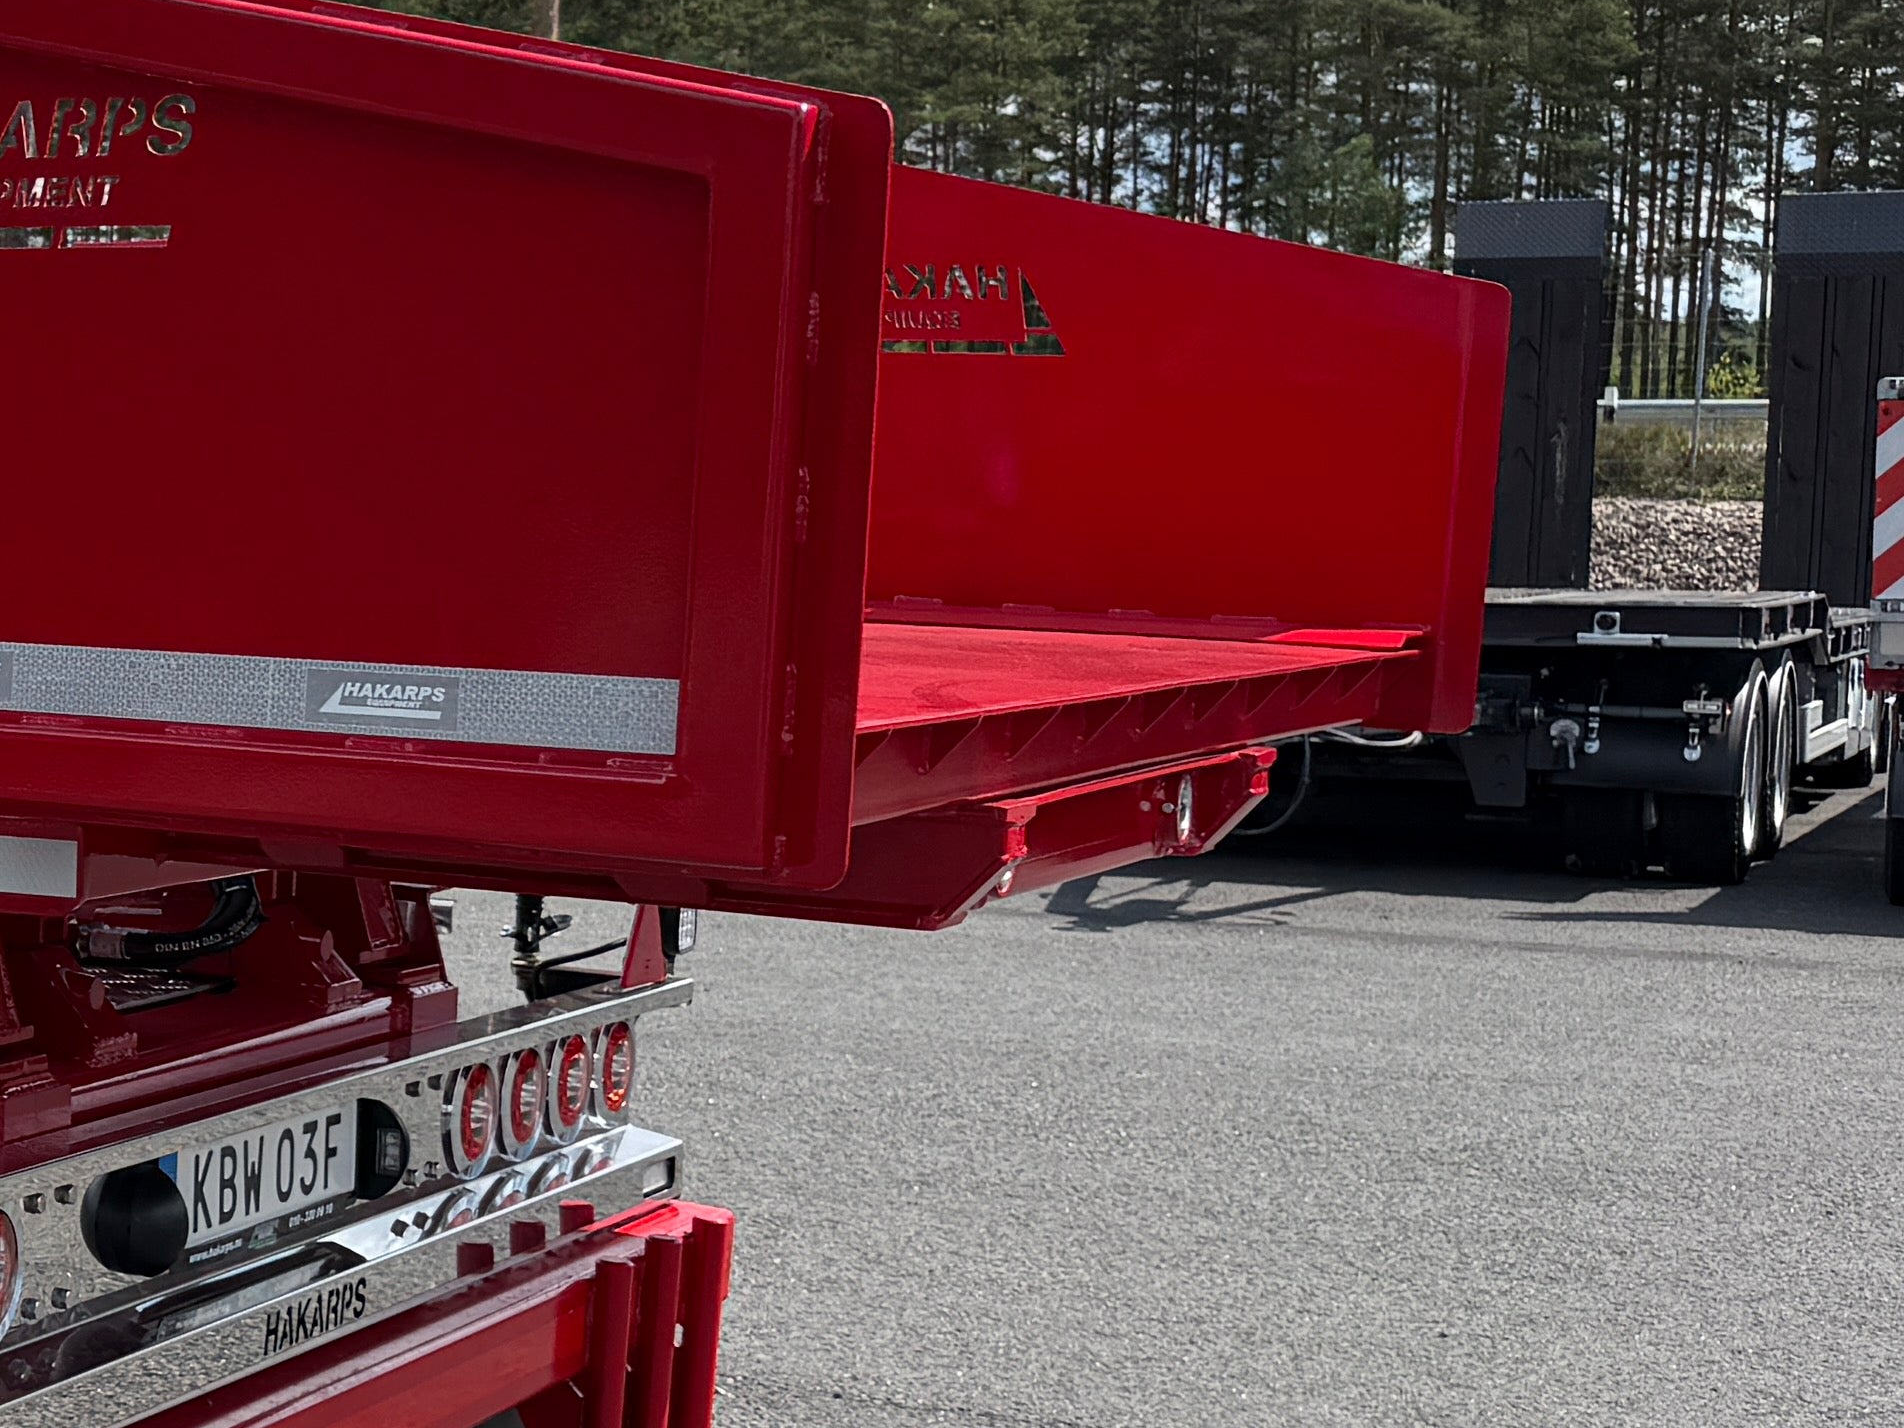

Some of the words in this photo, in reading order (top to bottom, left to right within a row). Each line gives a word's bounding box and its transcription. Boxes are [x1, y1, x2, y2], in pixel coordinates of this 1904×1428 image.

[344, 681, 446, 703] HAKARPS
[192, 1135, 265, 1234] KBW
[276, 1113, 342, 1204] 03F
[264, 1277, 367, 1356] HAKARPS
